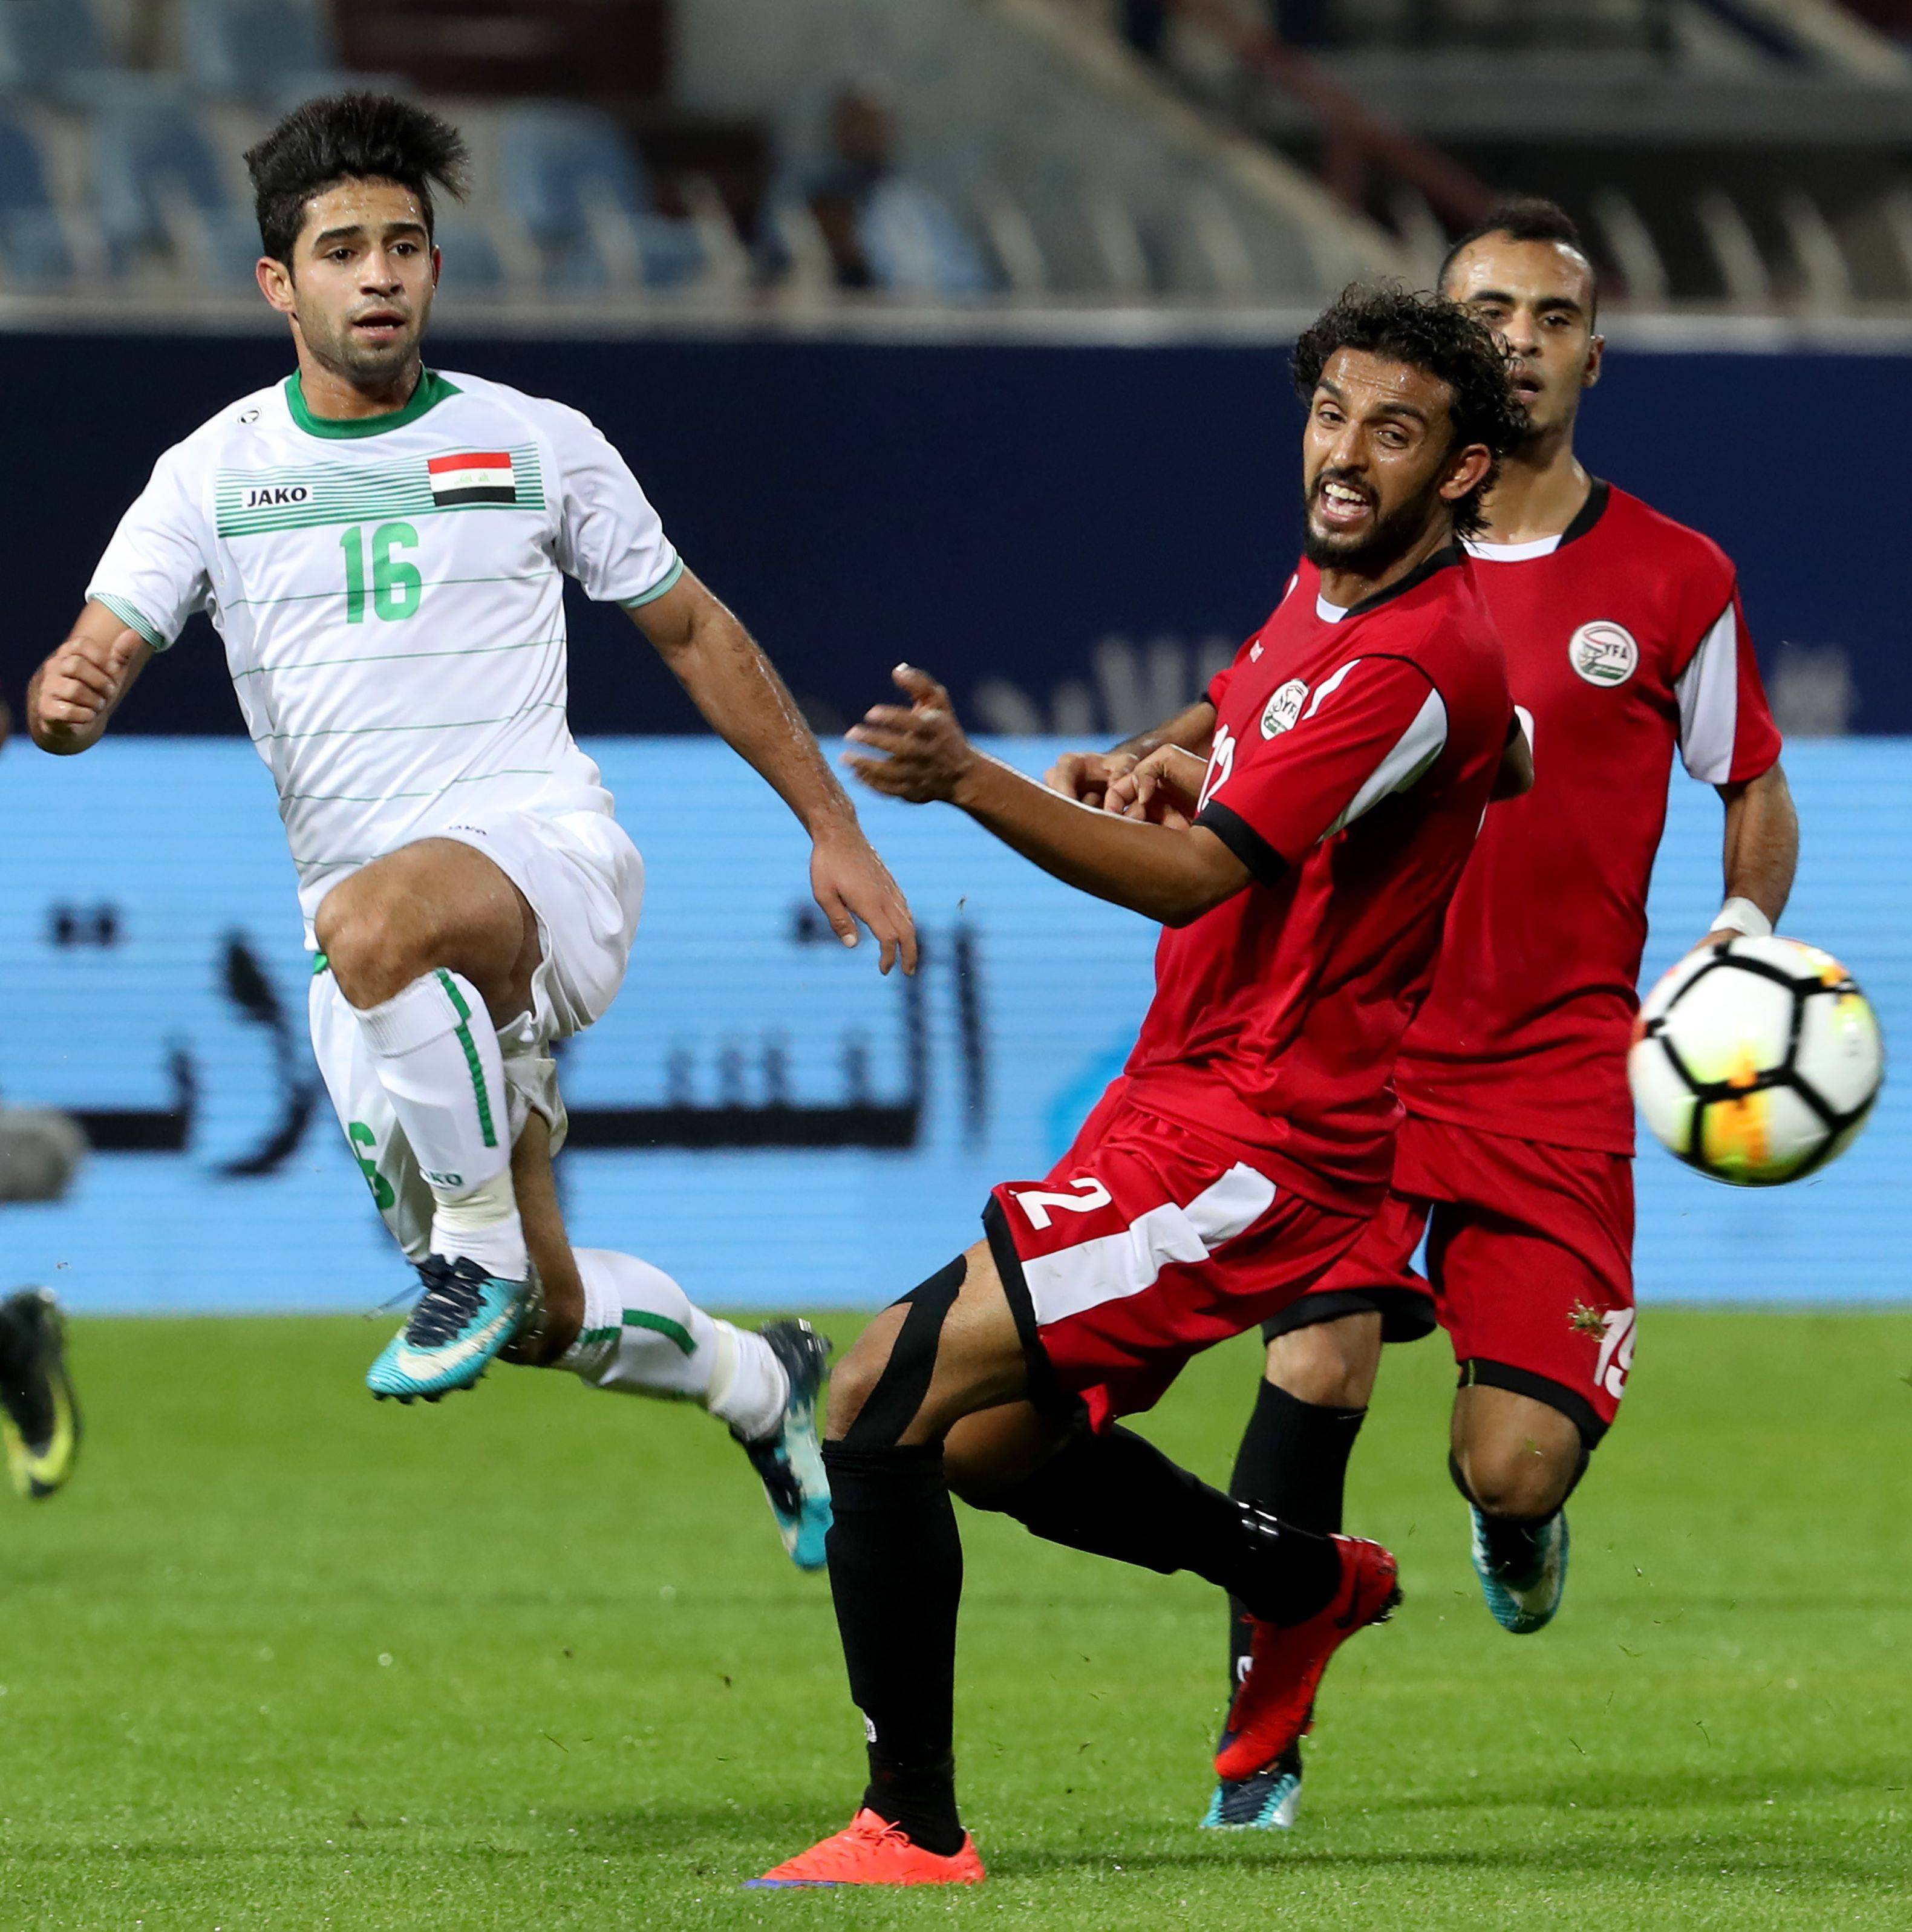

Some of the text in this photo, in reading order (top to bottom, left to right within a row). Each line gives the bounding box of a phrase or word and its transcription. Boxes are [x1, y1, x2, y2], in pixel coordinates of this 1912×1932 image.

[247, 487, 307, 507] JAKO
[340, 523, 422, 623] 16
[1009, 1177, 1113, 1230] 2
